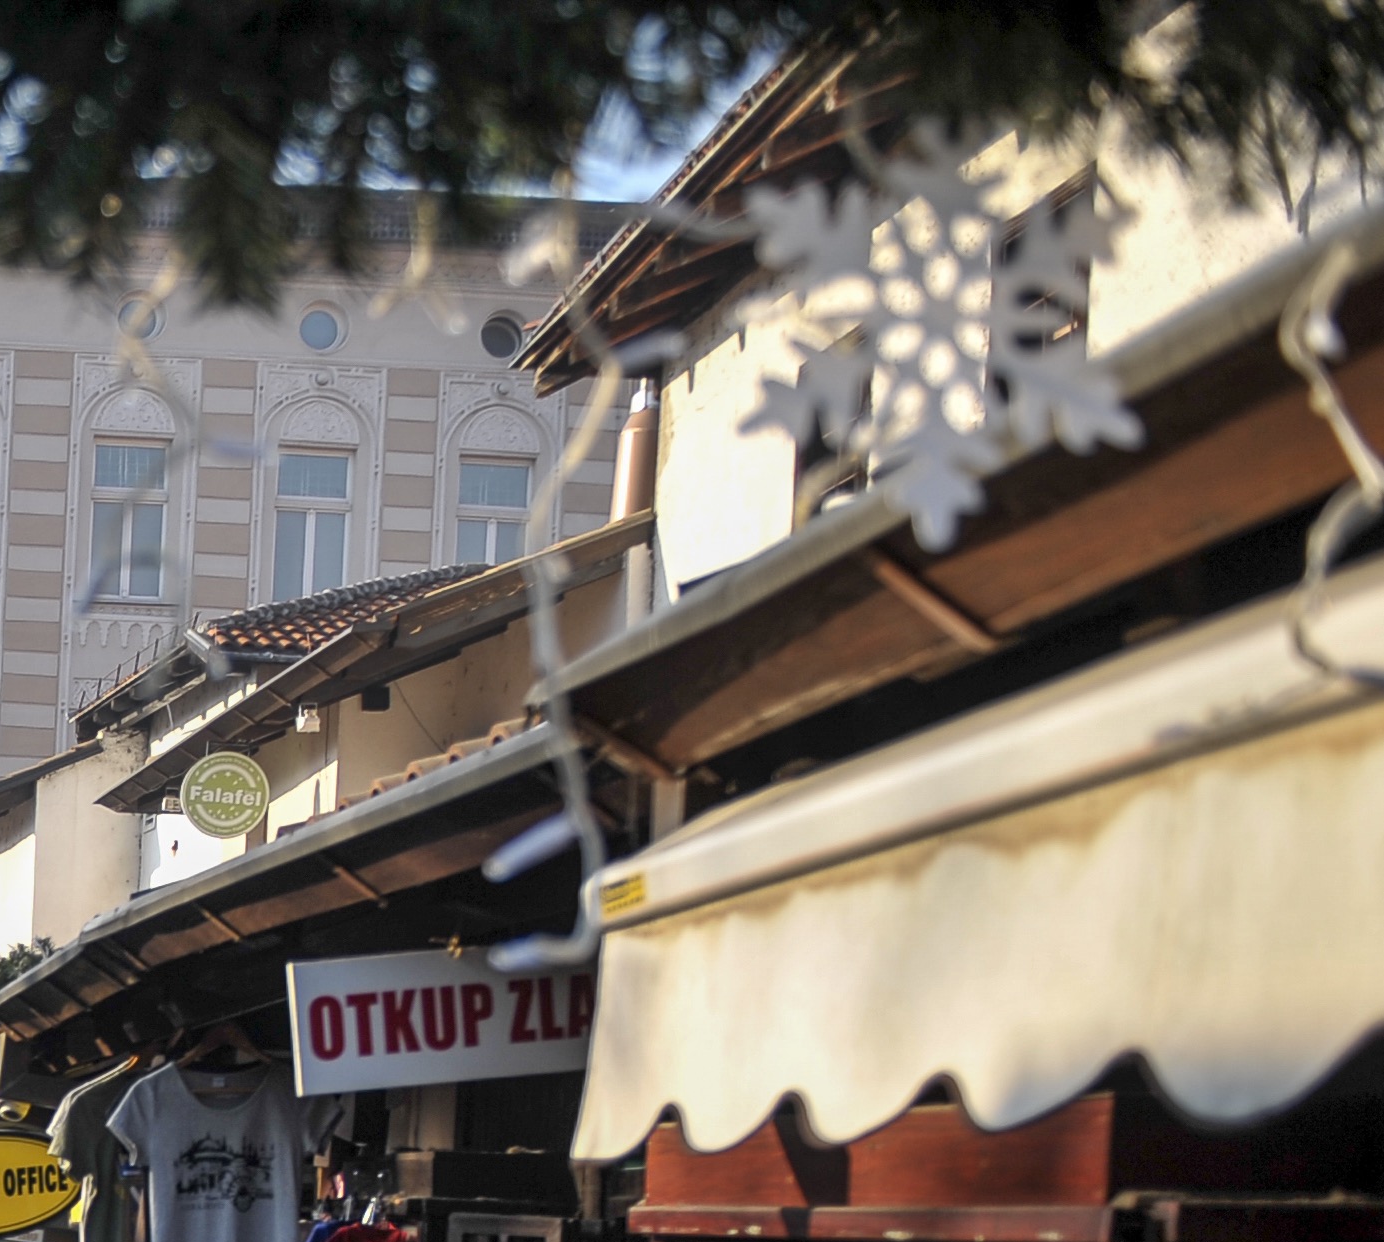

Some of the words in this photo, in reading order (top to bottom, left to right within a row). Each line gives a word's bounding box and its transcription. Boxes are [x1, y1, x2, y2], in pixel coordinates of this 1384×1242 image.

[189, 785, 263, 807] Falafel
[308, 982, 494, 1062] OTKUP
[507, 973, 595, 1045] ZLA
[3, 1163, 69, 1198] OFFICE
